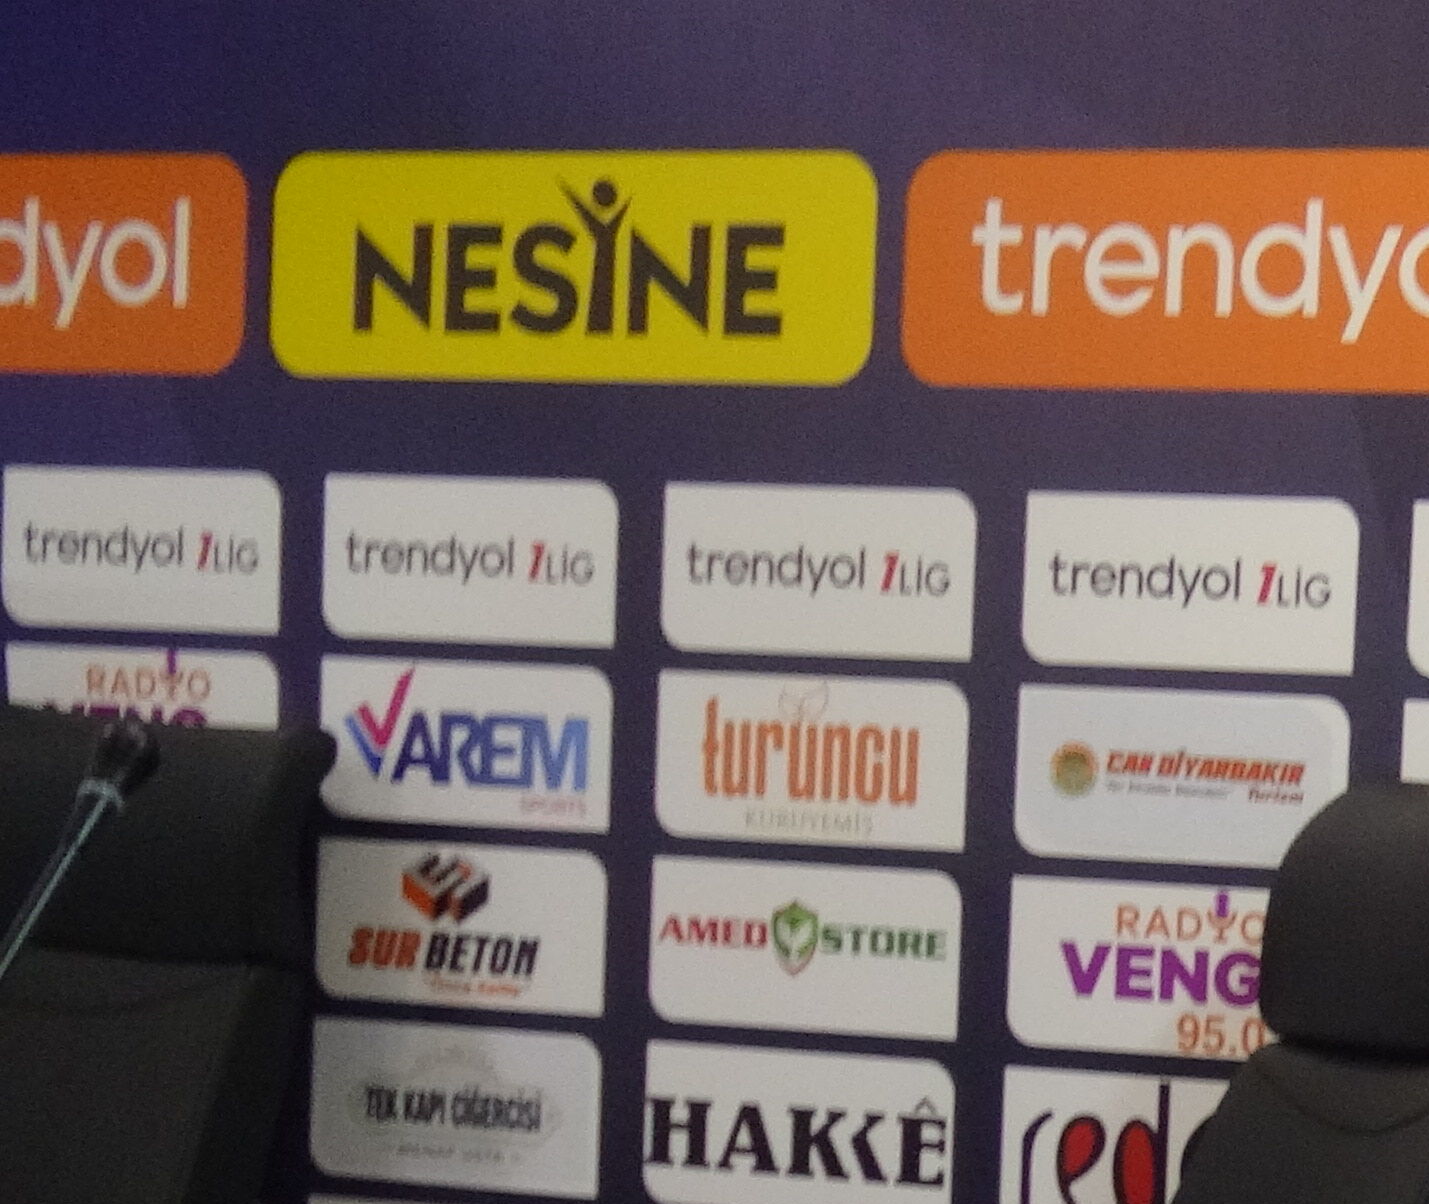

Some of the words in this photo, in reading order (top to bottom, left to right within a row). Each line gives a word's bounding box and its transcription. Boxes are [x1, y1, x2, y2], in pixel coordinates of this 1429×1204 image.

[0, 197, 191, 331] dyol
[23, 520, 185, 574] trendyol
[346, 529, 515, 585] trendyol
[686, 542, 866, 597] trendyol
[1049, 552, 1242, 610] trendyol
[86, 664, 211, 700] RADYO
[424, 930, 541, 977] BETON
[659, 913, 768, 949] AMED
[817, 925, 947, 962] STORE
